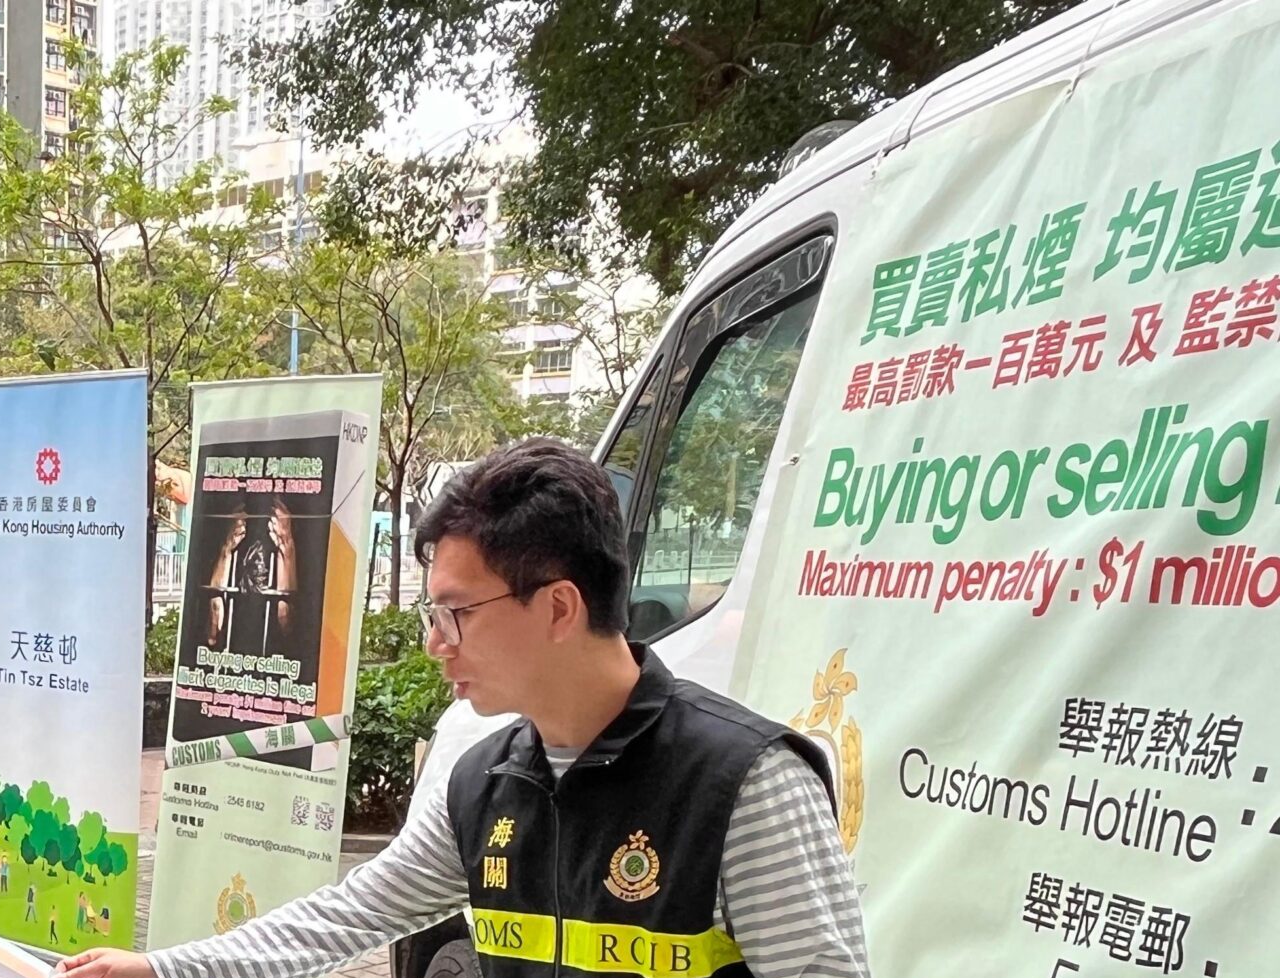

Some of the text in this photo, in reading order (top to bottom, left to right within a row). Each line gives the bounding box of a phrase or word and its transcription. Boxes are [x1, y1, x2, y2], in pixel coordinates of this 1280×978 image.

[860, 201, 1088, 346] 買賣私煙
[842, 315, 1107, 412] 最高罰款一百萬元
[1119, 302, 1164, 367] 及
[813, 403, 1269, 546] Buying or selling
[3, 520, 28, 537] Kong
[31, 520, 75, 538] Housing
[77, 521, 125, 539] Authority
[798, 550, 934, 599] Maximum
[1093, 536, 1145, 610] $1
[10, 630, 78, 665] 天慈邨
[20, 670, 43, 687] Tsz
[49, 673, 90, 693] Estate
[197, 646, 301, 679] Buying or selling
[205, 671, 265, 695] cigarettes
[265, 677, 278, 696] is
[172, 739, 221, 766] CUSTOMS
[1058, 697, 1244, 779] 舉報熱線
[176, 827, 198, 839] Email
[899, 747, 1050, 827] Customs
[1060, 775, 1217, 862] Hotline
[483, 816, 516, 890] 海關
[1022, 872, 1191, 975] 舉報電郵
